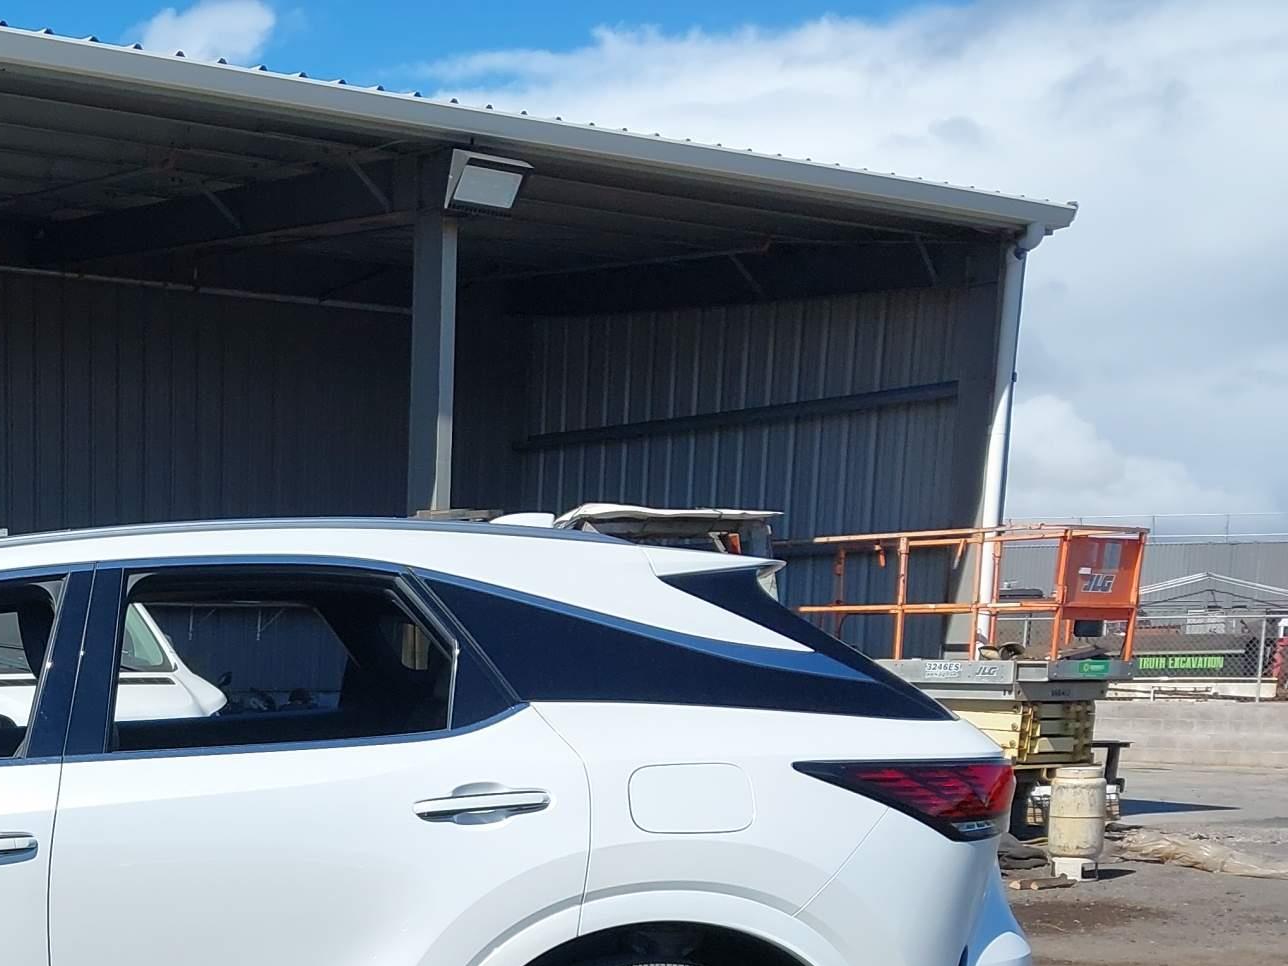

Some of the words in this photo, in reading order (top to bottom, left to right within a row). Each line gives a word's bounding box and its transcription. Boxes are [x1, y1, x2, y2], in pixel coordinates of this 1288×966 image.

[926, 662, 961, 671] 3246ES
[1139, 656, 1166, 669] TRUTH
[1168, 655, 1225, 669] EXCAVATION
[975, 665, 999, 677] JLG
